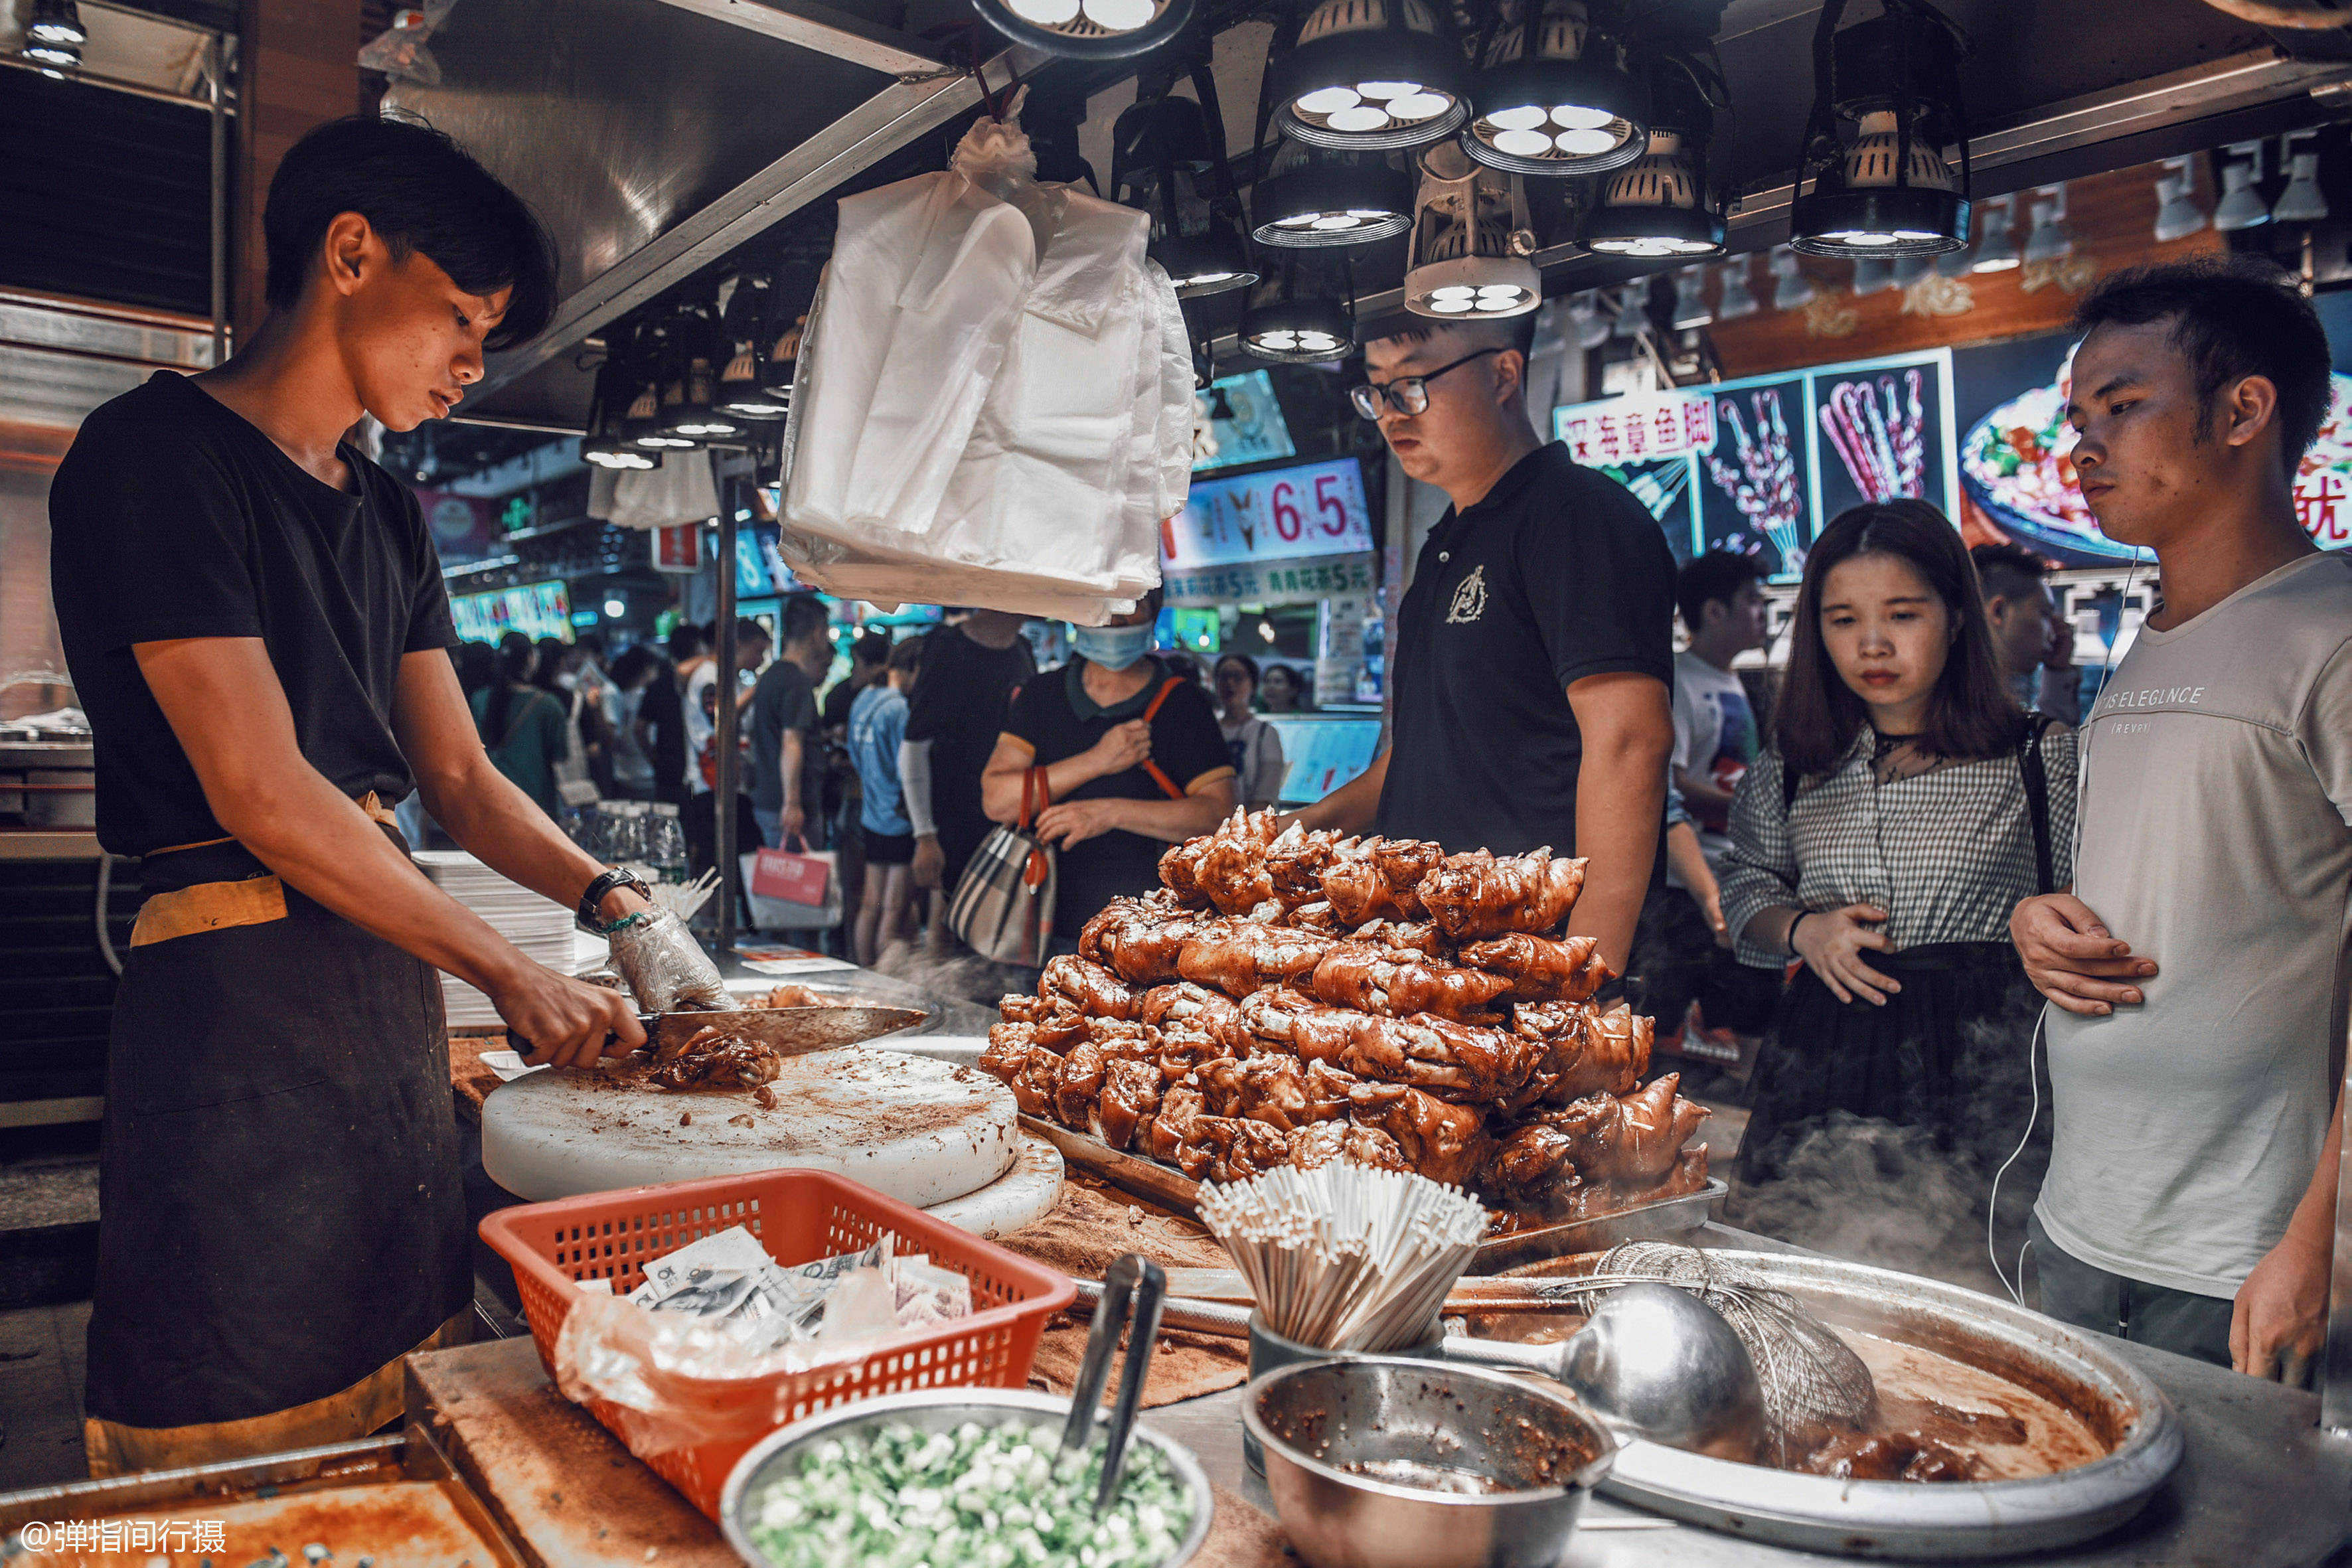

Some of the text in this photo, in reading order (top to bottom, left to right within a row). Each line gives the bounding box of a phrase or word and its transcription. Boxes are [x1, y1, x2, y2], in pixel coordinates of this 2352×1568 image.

[1565, 400, 1710, 460] 深海章鱼脚
[1271, 481, 1302, 542] 6
[1315, 475, 1347, 536] 5
